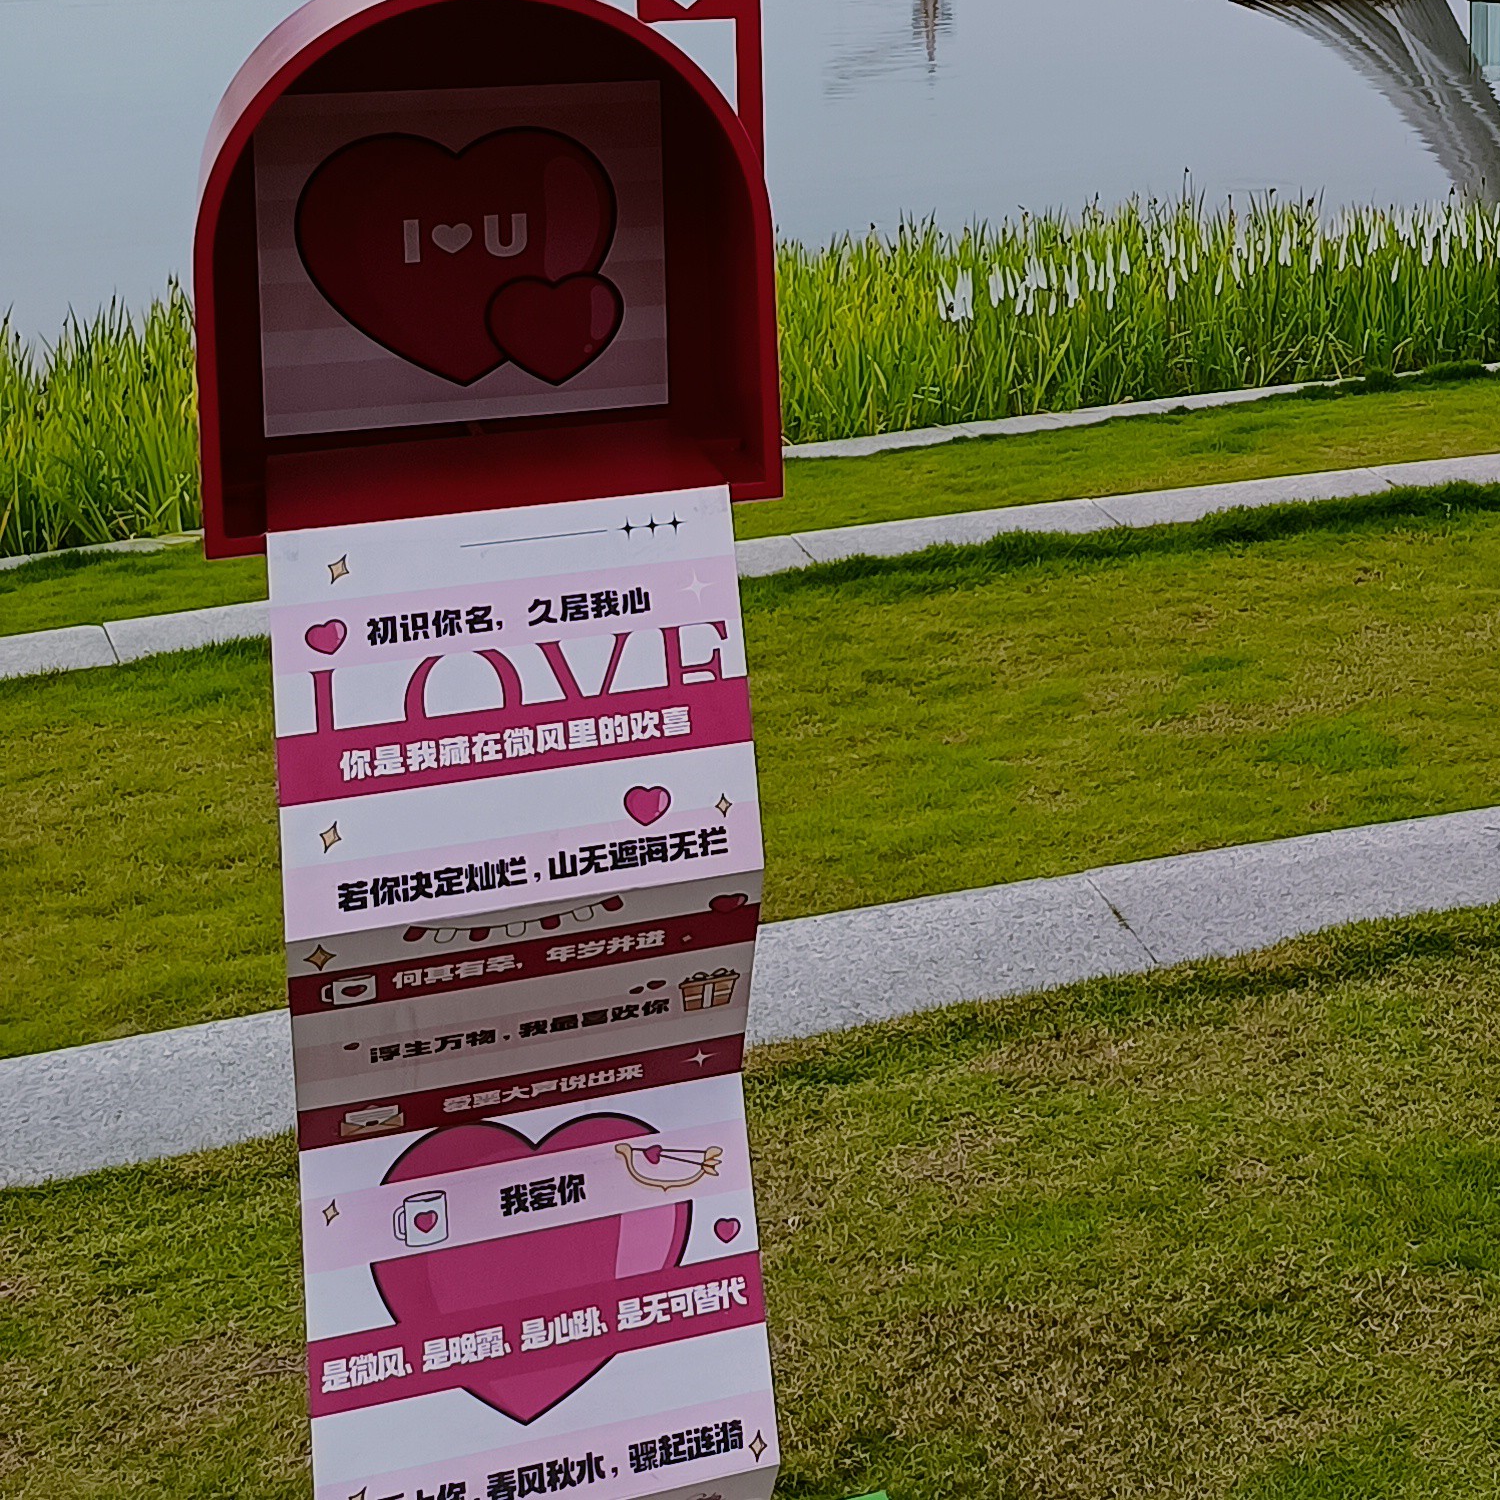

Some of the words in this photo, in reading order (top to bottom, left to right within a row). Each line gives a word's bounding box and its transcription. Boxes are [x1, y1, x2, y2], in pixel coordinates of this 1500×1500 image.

[403, 219, 421, 263] I
[484, 213, 528, 257] U
[339, 706, 692, 782] 你是我藏在微风里的欢喜
[500, 1174, 587, 1216] 我爱你
